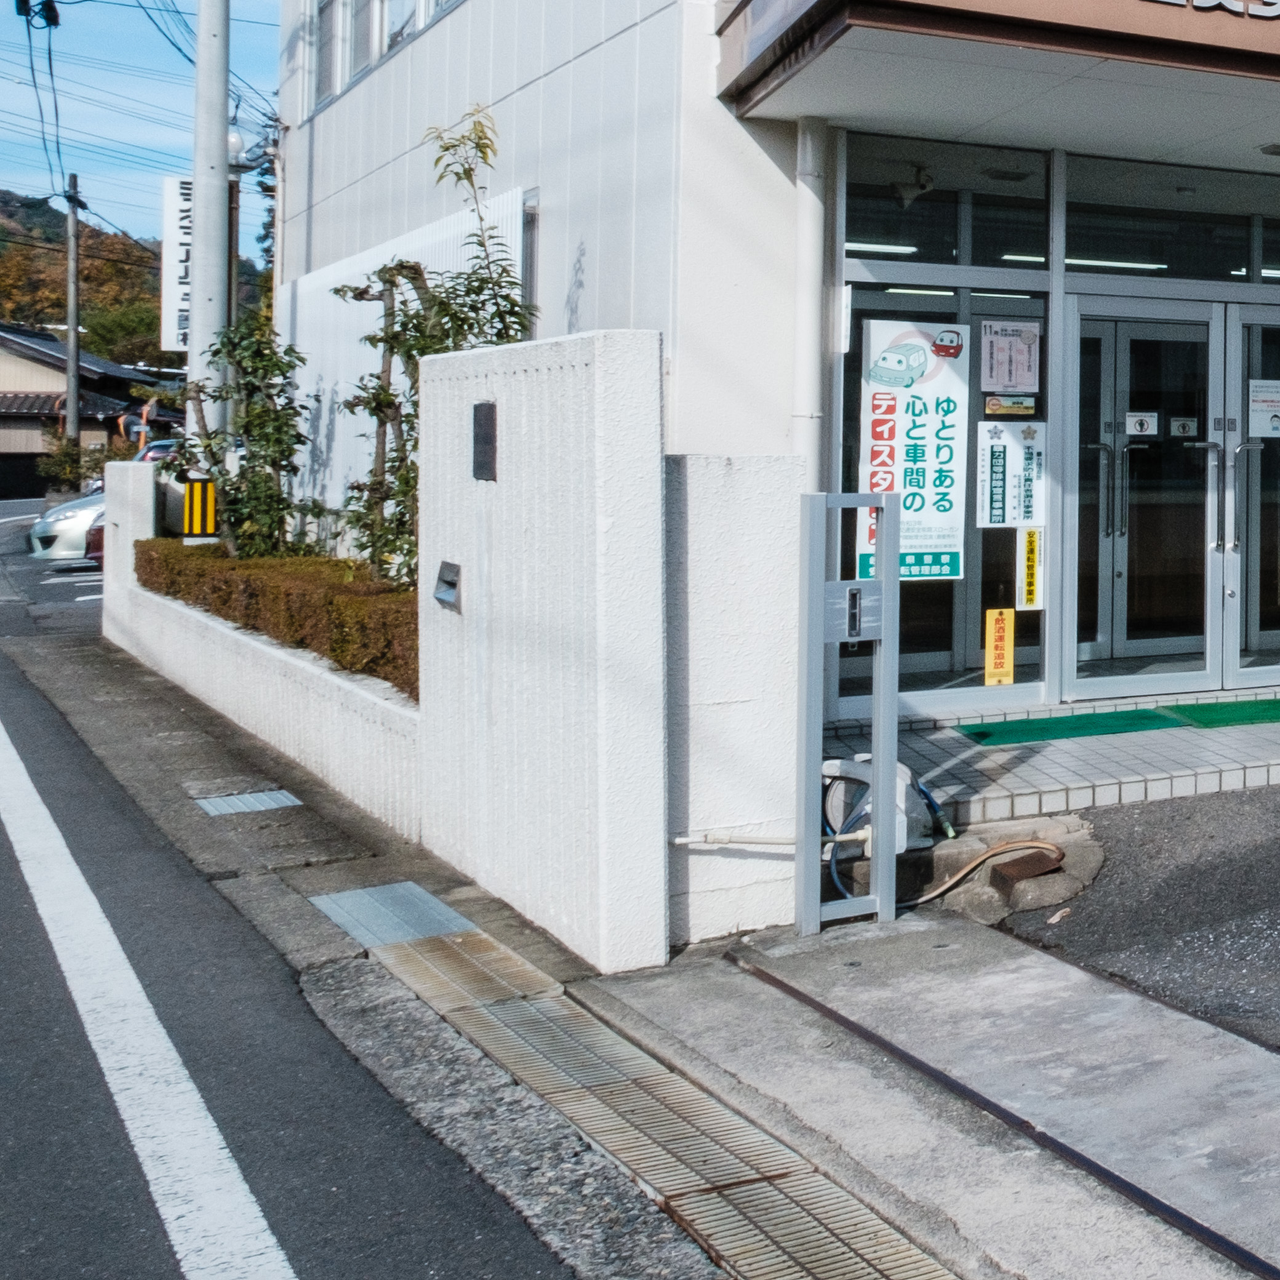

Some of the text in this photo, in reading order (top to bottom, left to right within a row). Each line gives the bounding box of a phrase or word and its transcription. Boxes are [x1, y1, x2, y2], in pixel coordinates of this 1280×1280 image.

[869, 393, 896, 545] ディスタ
[902, 394, 928, 512] 心と車間の
[932, 395, 957, 512] ゆとりある
[993, 617, 1006, 669] 飲酒運転追放
